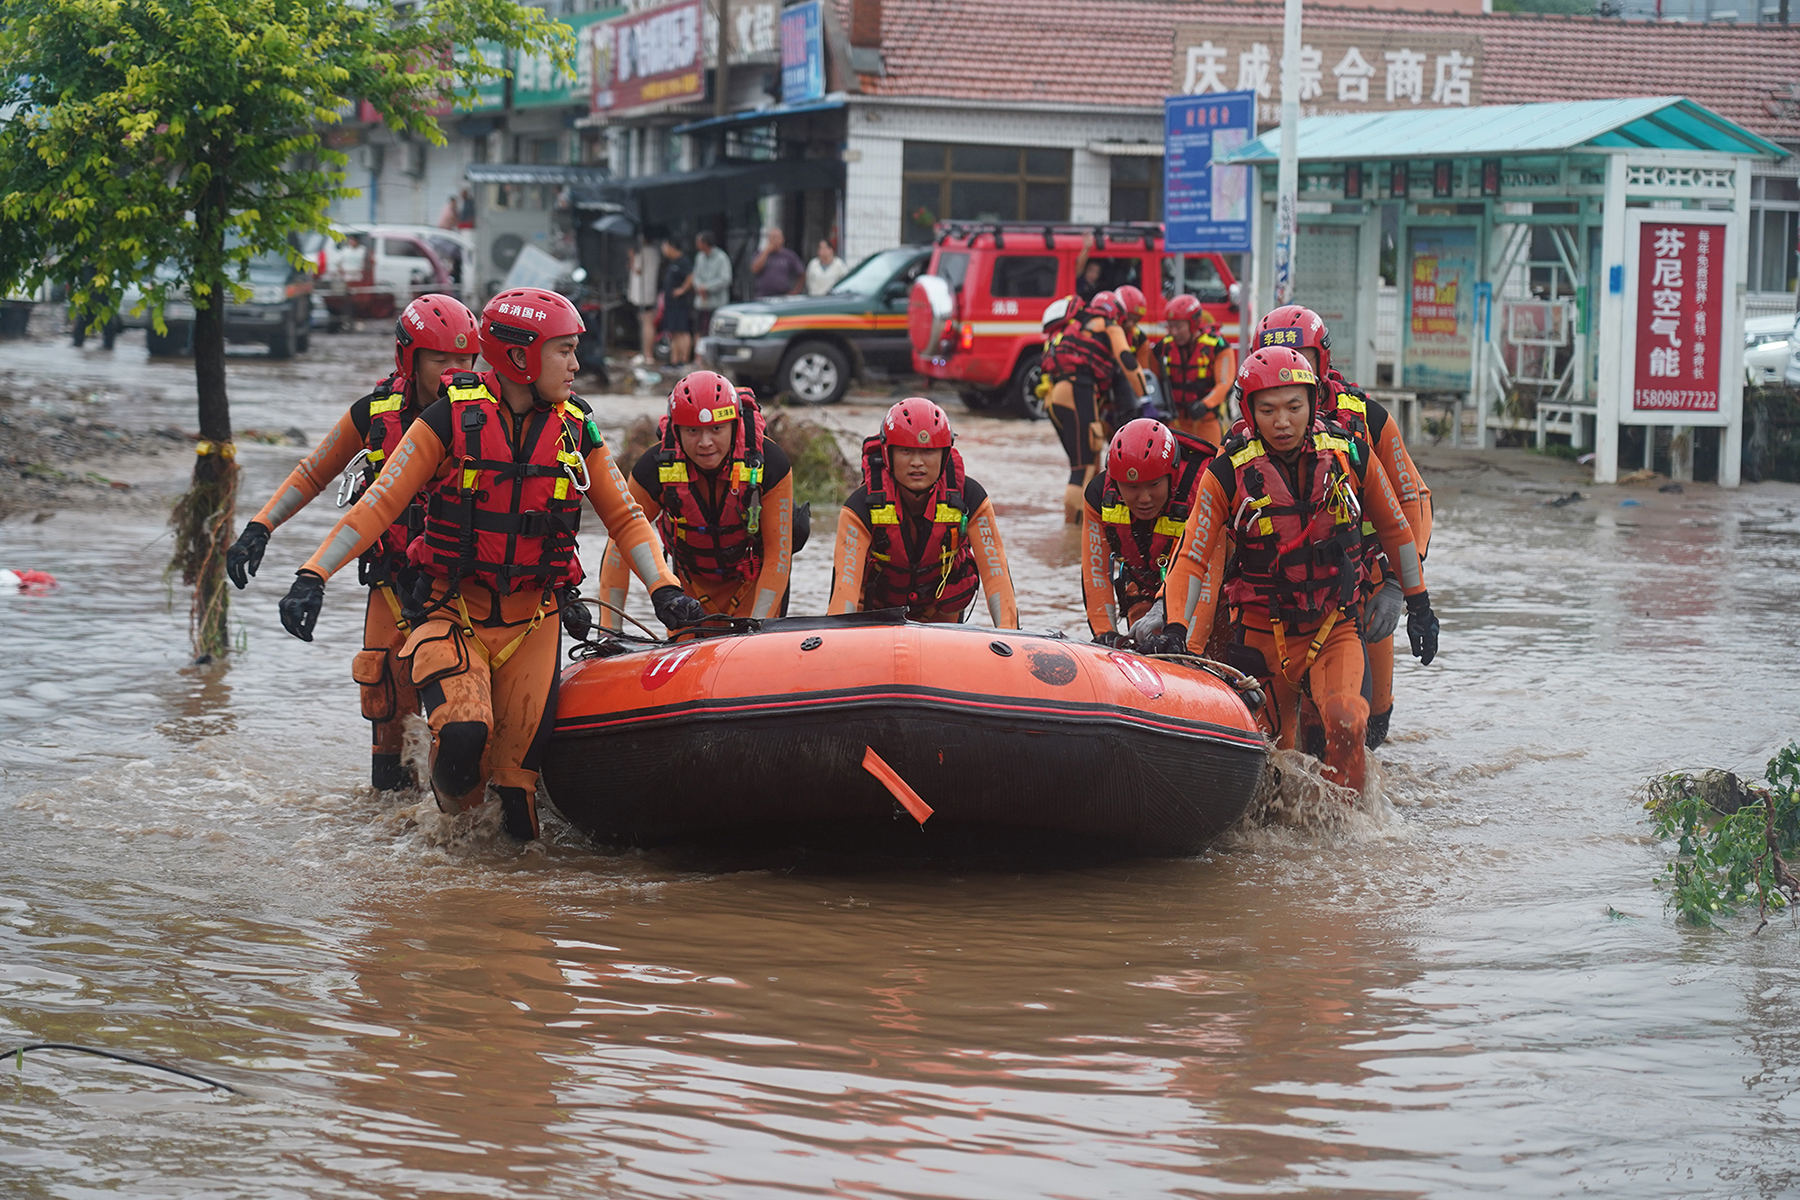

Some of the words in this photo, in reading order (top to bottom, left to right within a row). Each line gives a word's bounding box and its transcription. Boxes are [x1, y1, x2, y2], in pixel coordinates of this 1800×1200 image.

[1182, 40, 1474, 105] 庆成综合商店
[1649, 227, 1686, 378] 芬尼空气能
[1264, 330, 1297, 346] 李思奇
[1635, 389, 1717, 409] 15809877222
[297, 424, 342, 479] RESCUE
[361, 437, 416, 509] RESCUE
[1391, 436, 1418, 503] RESCUE
[604, 454, 647, 521] RESCUE
[1376, 465, 1410, 531] RESCUE
[777, 498, 790, 576] RESCUE
[842, 524, 859, 588] RESCUE
[976, 516, 1004, 577] RESCUE
[1087, 519, 1107, 590] RESCUE
[1187, 487, 1213, 565] RESCUE
[650, 649, 693, 677] 11
